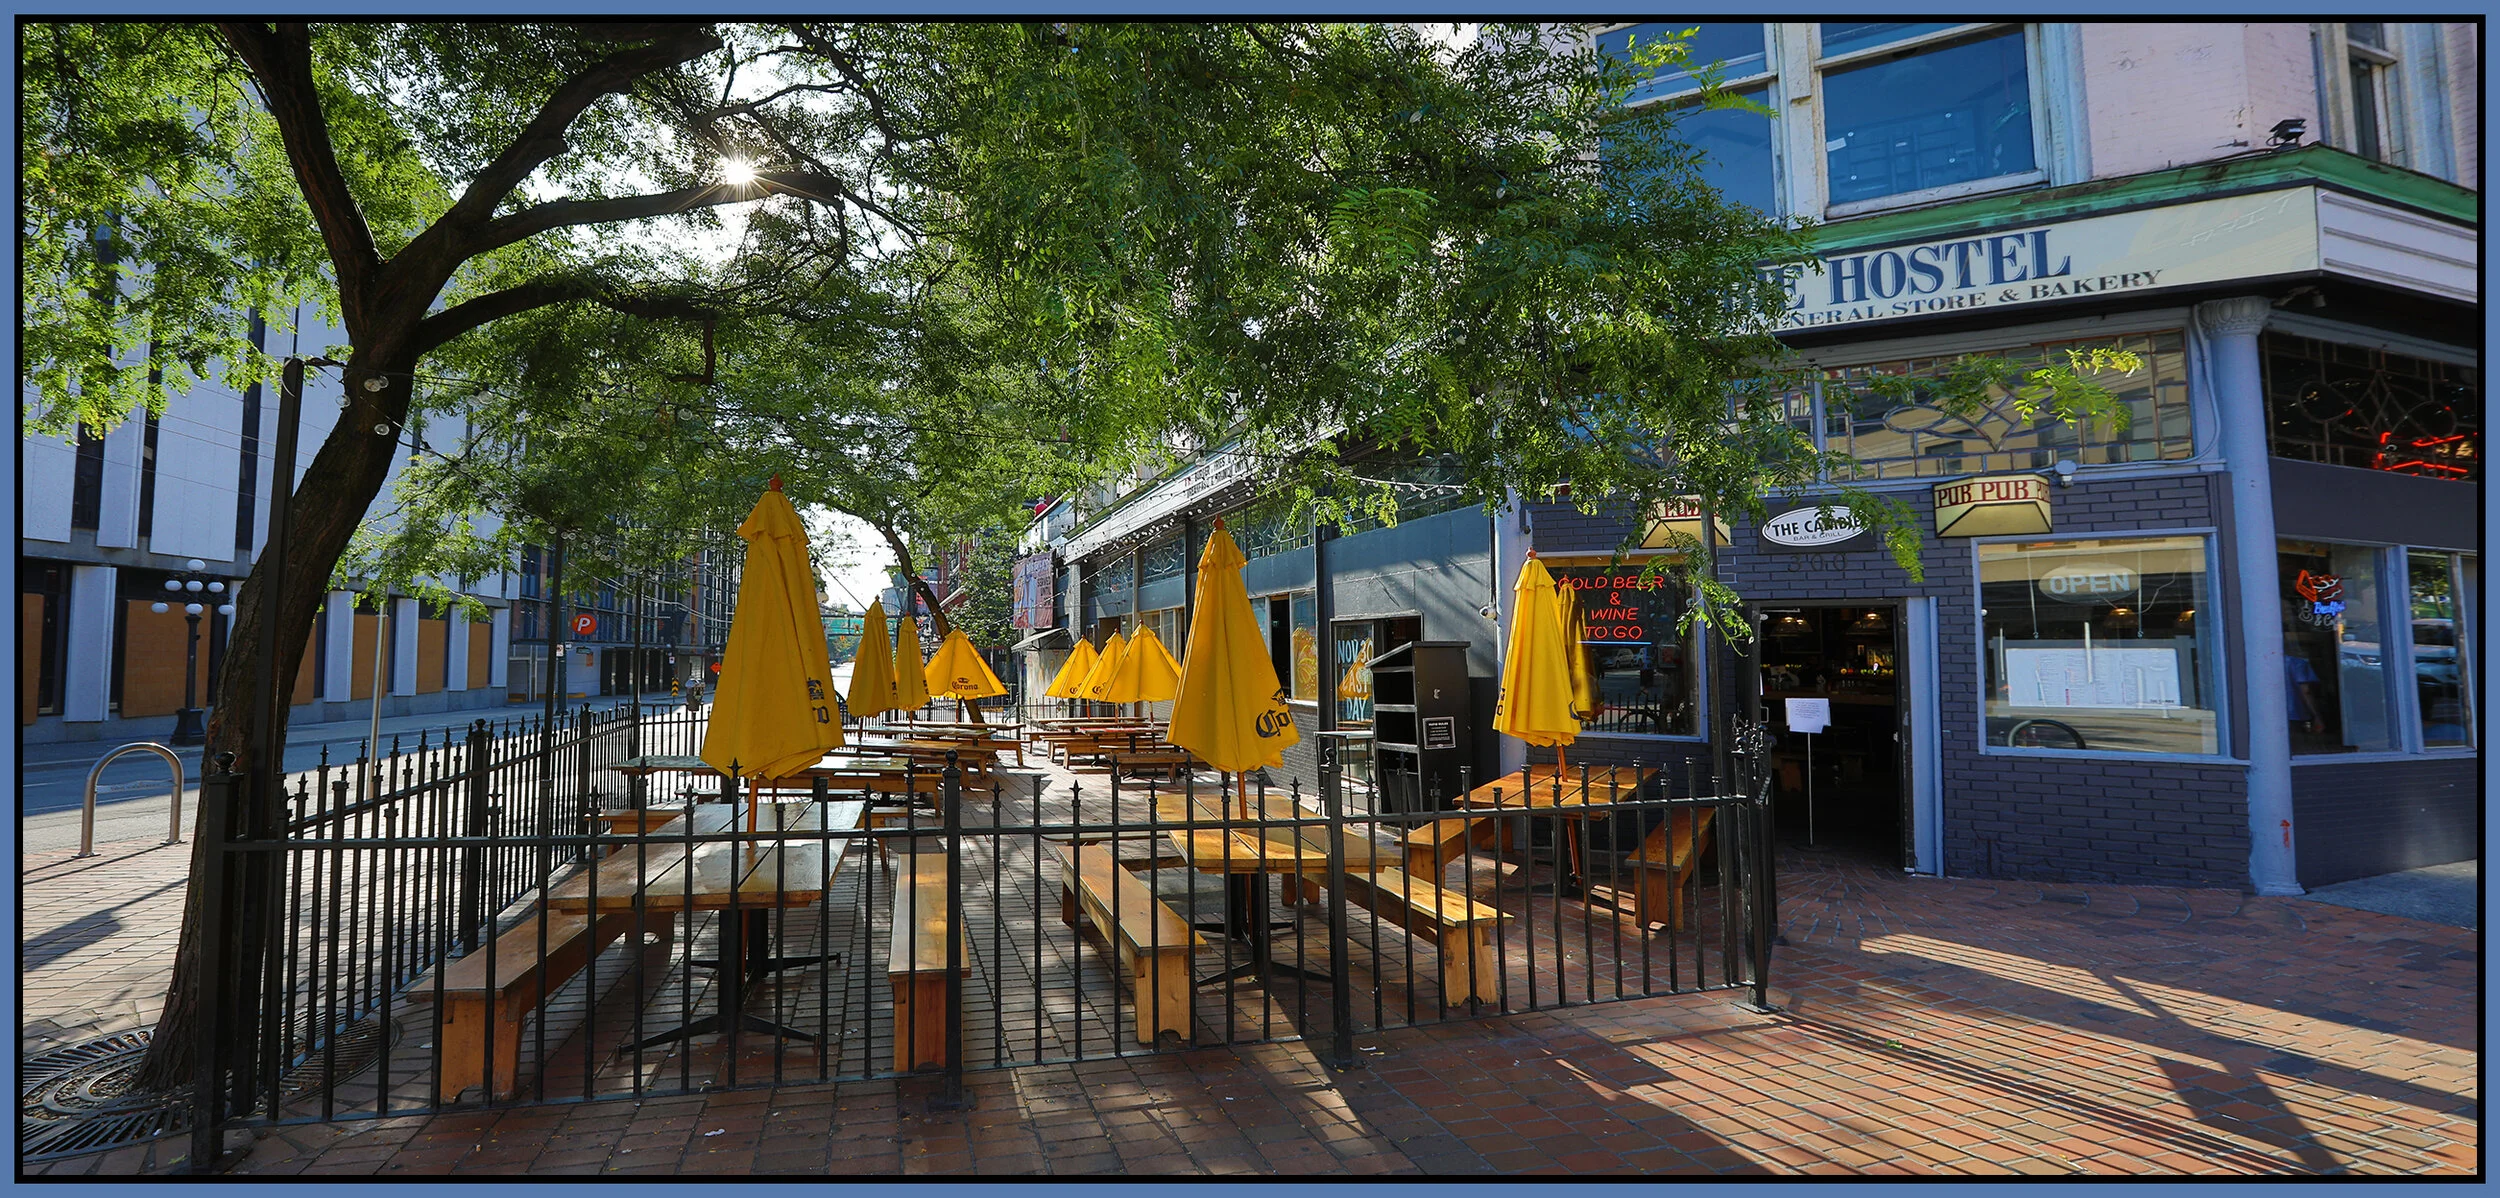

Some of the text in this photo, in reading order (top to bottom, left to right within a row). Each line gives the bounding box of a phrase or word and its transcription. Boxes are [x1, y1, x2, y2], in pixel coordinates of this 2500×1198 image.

[1827, 229, 2071, 306] HOSTEL
[1774, 268, 2164, 330] ENERAL STORE & BAKERY
[1937, 483, 1972, 507] PUB
[1981, 480, 2029, 500] PUB
[1772, 522, 1799, 536] THE
[1788, 554, 1846, 572] 300
[1558, 576, 1608, 591] COLD
[2049, 572, 2130, 594] OPEN
[1609, 592, 1621, 605] &
[1591, 607, 1639, 620] WINE
[577, 617, 591, 632] P
[1585, 625, 1643, 640] TO GO
[1337, 639, 1374, 664] NOV 30
[952, 681, 978, 690] Corona
[1342, 667, 1372, 694] LAST
[1346, 697, 1367, 722] DAY
